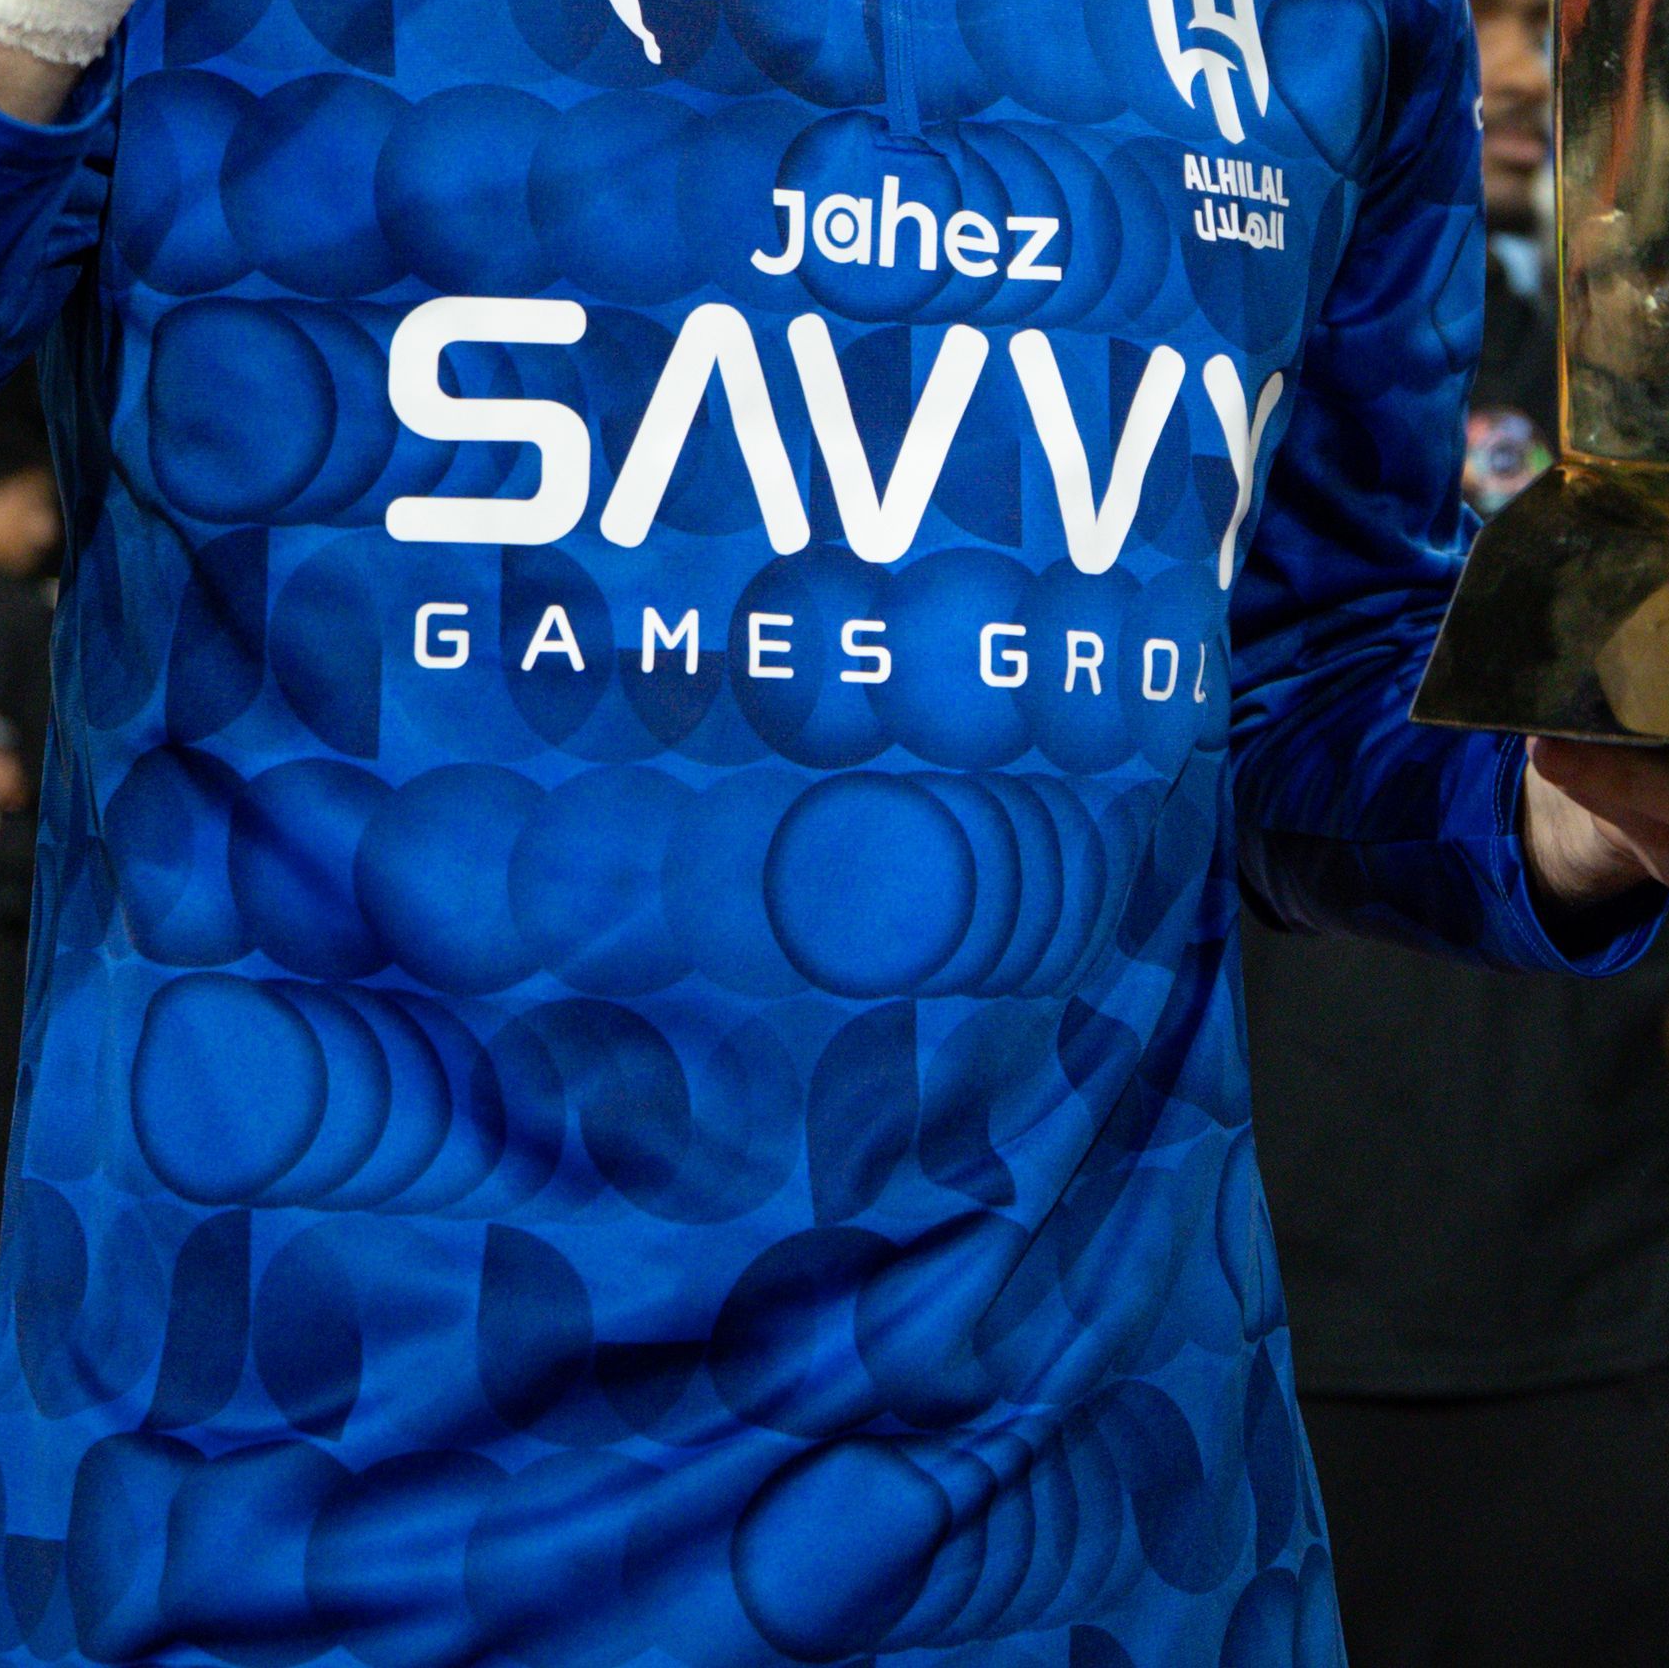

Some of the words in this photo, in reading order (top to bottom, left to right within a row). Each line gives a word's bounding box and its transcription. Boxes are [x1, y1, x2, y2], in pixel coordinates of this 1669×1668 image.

[751, 175, 1063, 281] Jahez
[1194, 198, 1284, 250] الهلال
[385, 296, 1284, 590] SAVVY
[413, 602, 892, 685] GAMES
